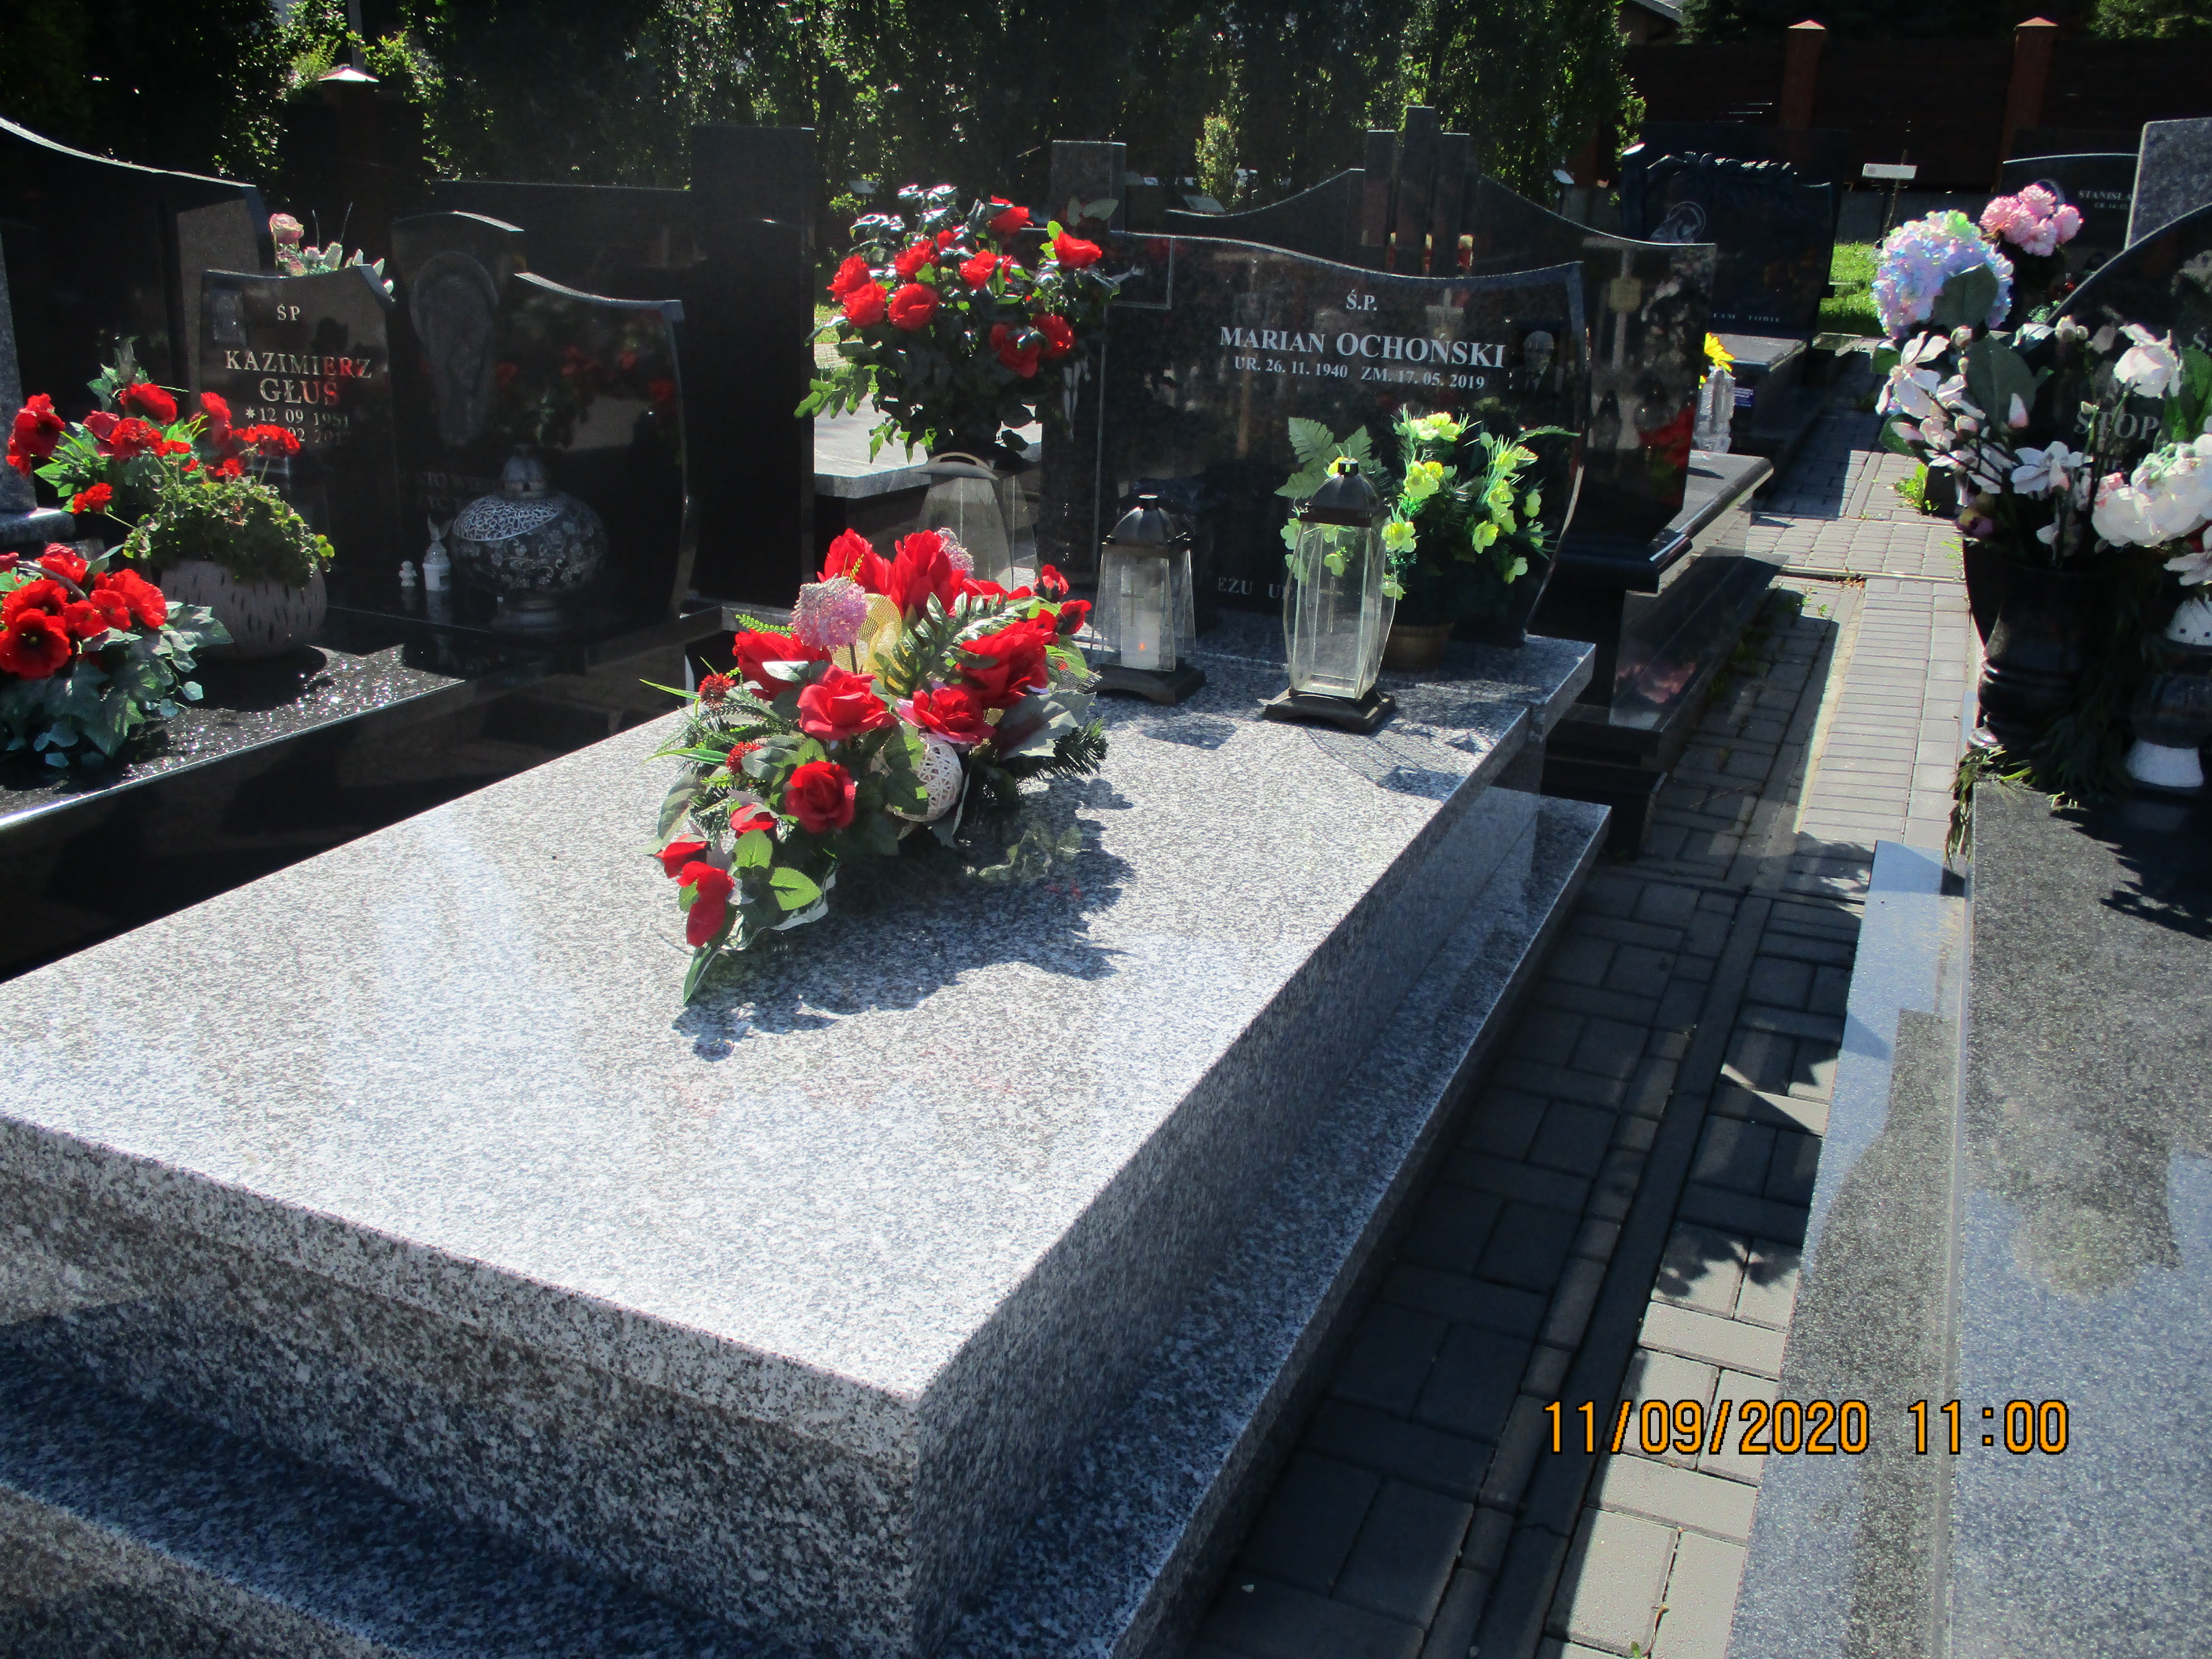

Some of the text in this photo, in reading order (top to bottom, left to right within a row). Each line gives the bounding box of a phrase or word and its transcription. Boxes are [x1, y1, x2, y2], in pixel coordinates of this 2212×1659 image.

[1346, 289, 1378, 310] Ś.P.
[1220, 326, 1506, 368] MARIAN OCHOŃSKI
[224, 349, 372, 379] KAZIMIERZ
[1234, 356, 1485, 389] UR. 26. 11. 1940 ZM. 17. 05. 2019
[285, 408, 304, 424] 09
